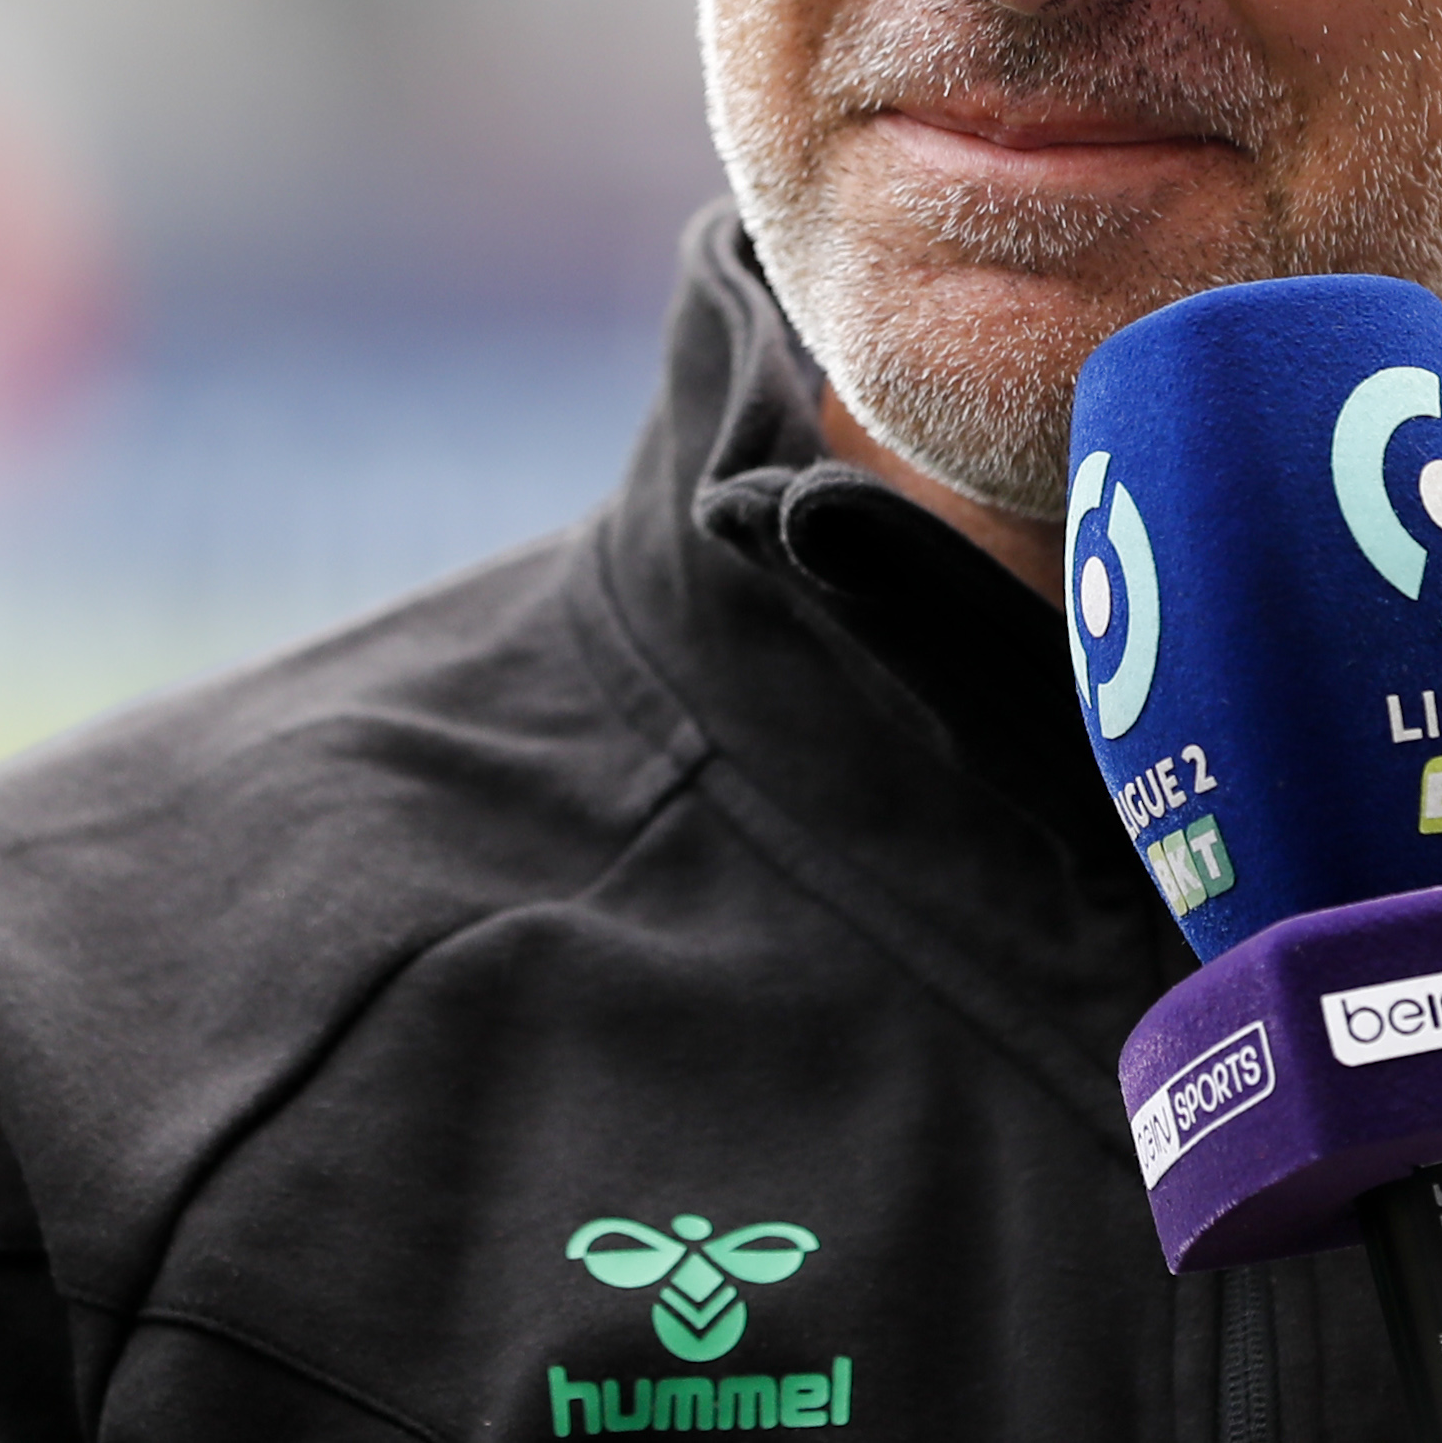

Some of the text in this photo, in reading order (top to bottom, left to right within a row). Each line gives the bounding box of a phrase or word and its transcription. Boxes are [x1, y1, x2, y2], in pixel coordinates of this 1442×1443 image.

[1114, 743, 1219, 842] LIGUE 2
[1151, 828, 1222, 904] BKT
[1173, 1044, 1262, 1132] SPORTS
[547, 1355, 853, 1438] hummel
